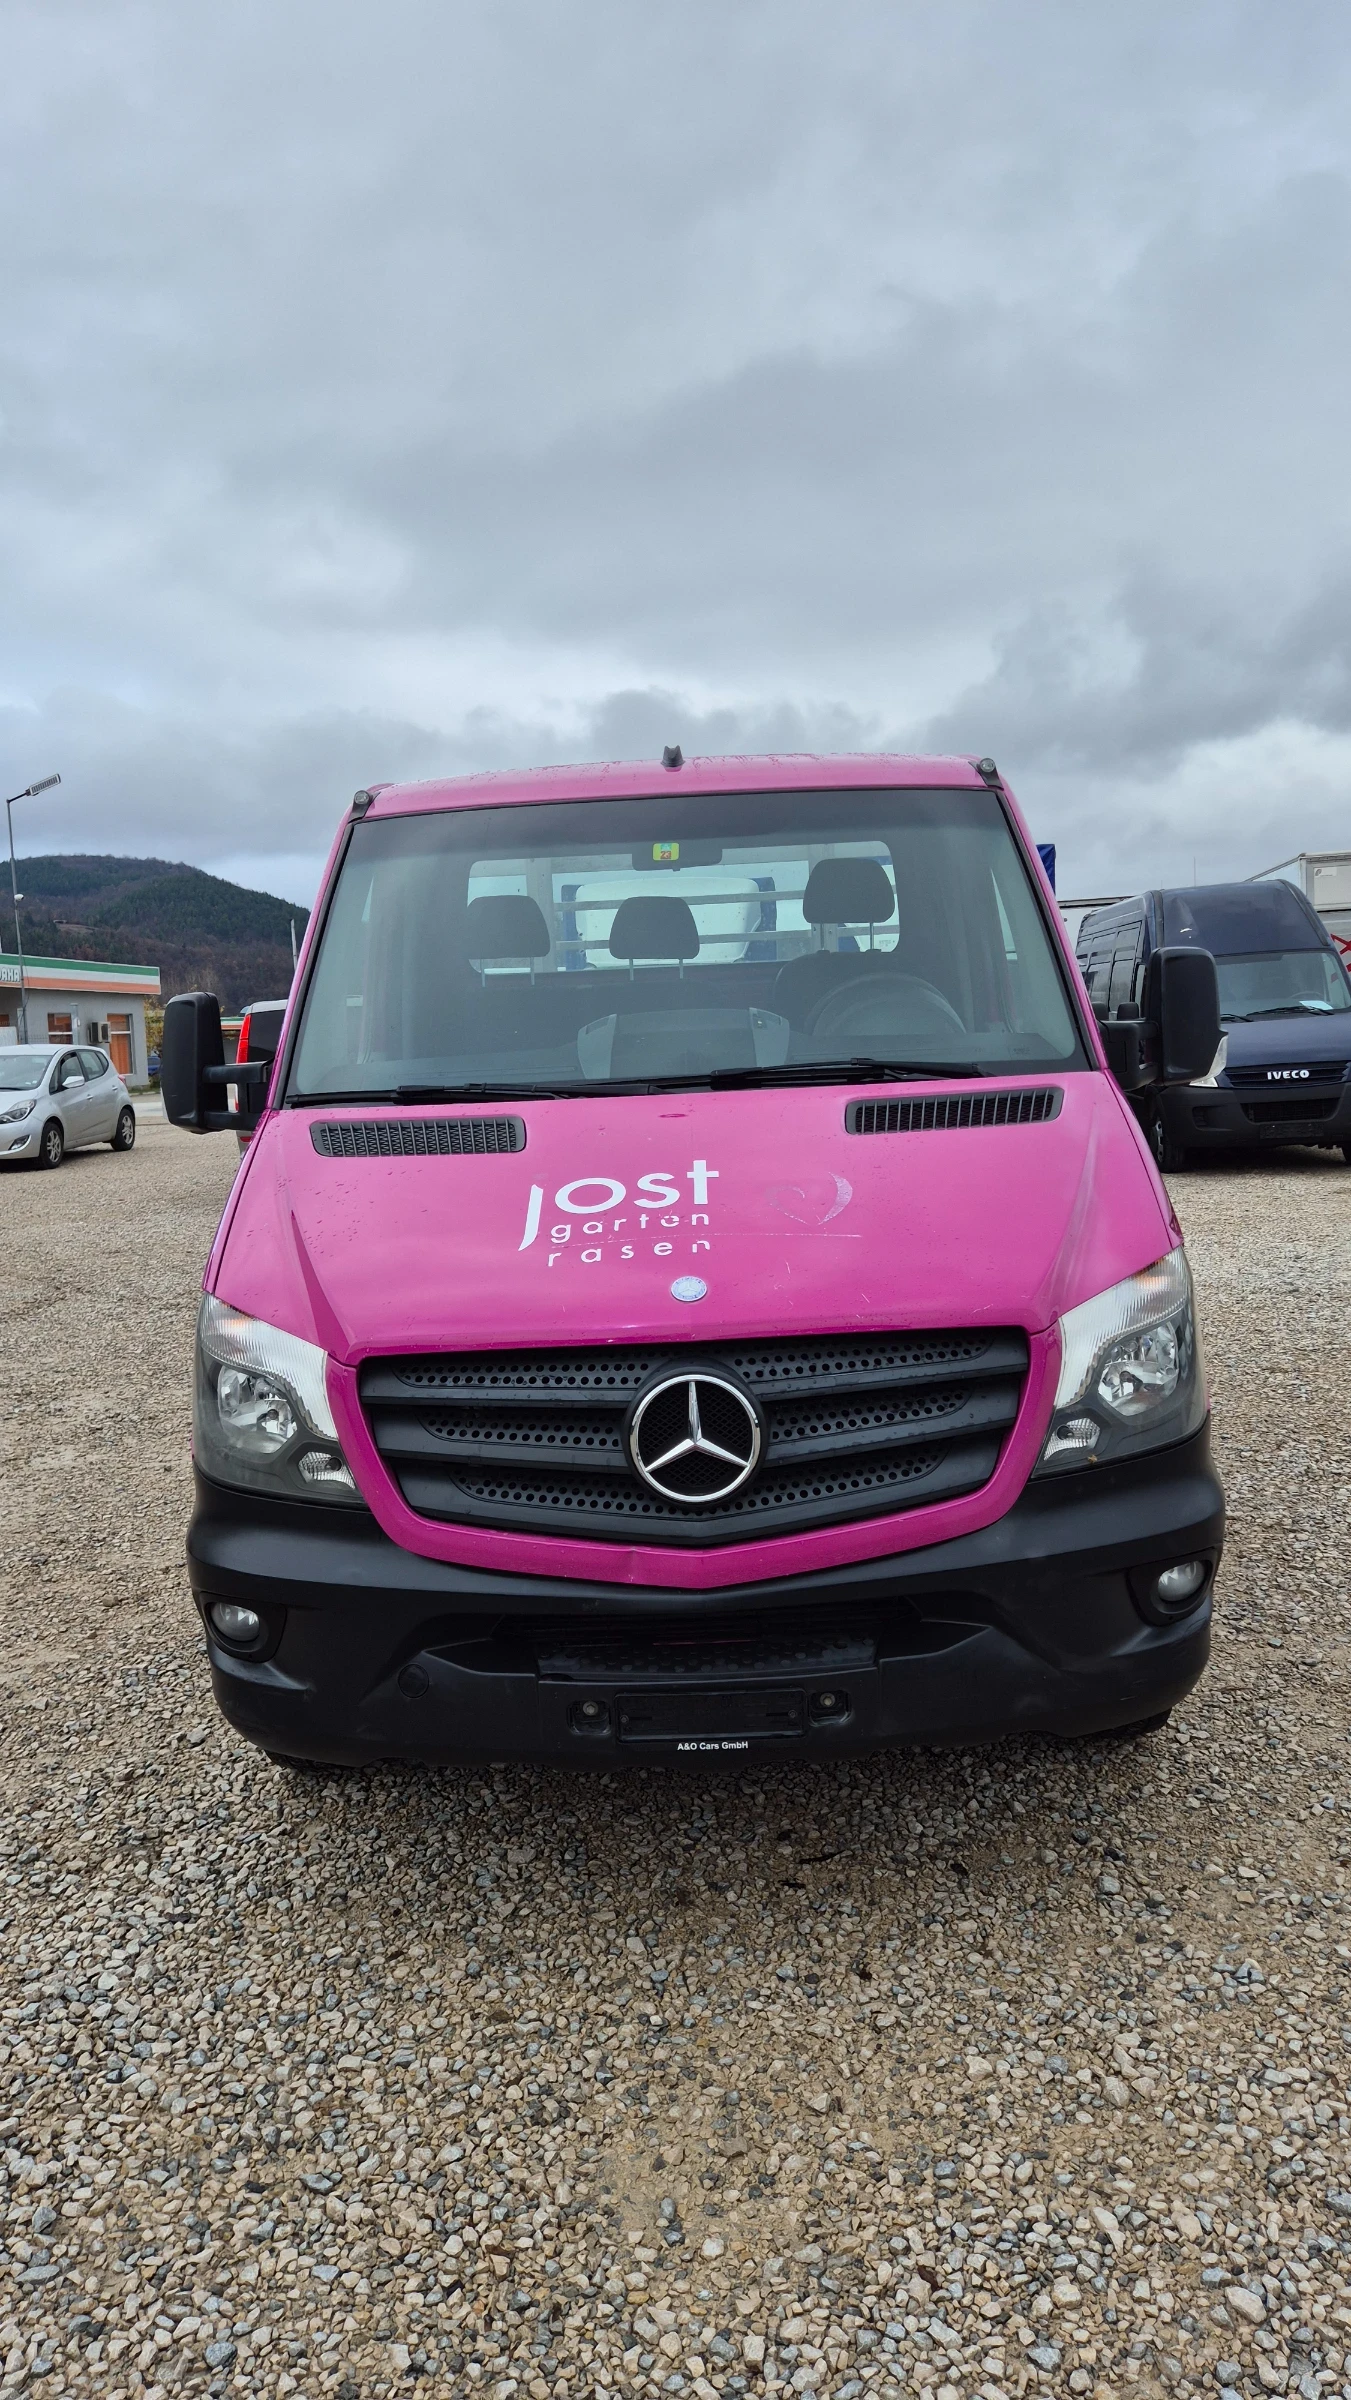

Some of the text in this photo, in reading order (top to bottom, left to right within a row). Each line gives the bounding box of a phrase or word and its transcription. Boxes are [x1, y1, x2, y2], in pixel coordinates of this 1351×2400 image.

[1267, 1070, 1310, 1080] IVECO
[550, 1213, 710, 1244] garten
[547, 1240, 711, 1267] rasen
[677, 1741, 749, 1751] A&O Cars GmbH
